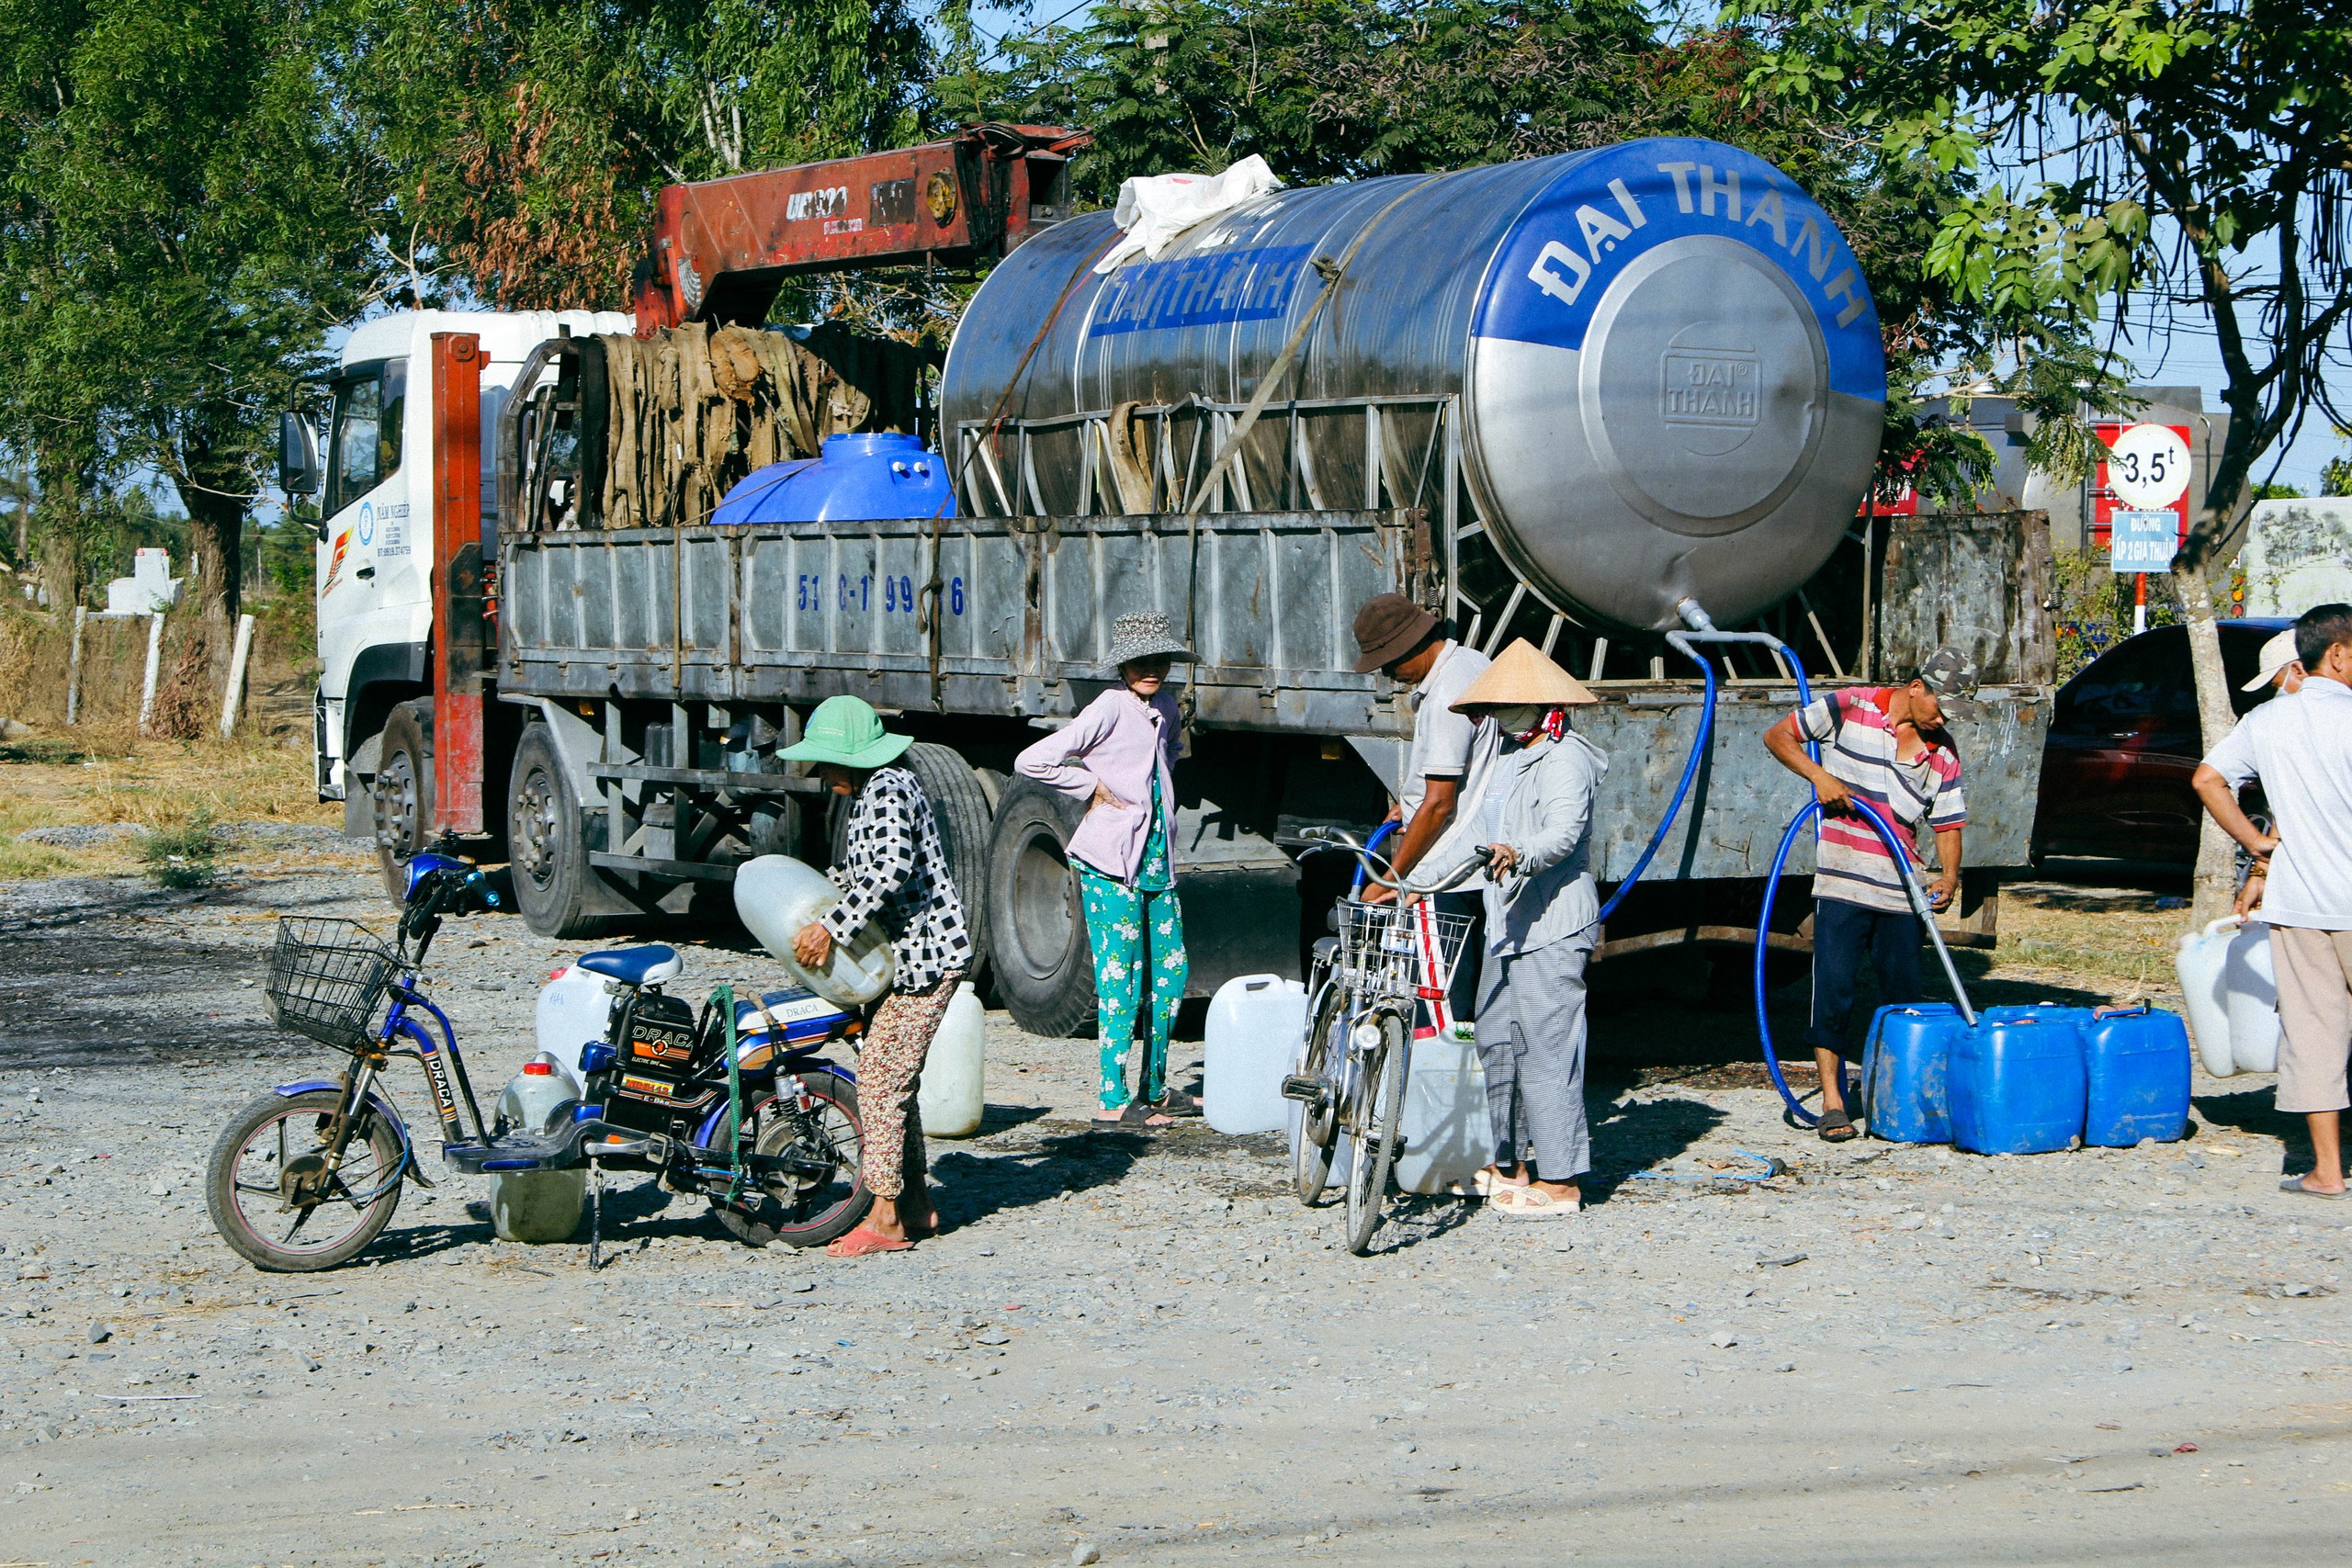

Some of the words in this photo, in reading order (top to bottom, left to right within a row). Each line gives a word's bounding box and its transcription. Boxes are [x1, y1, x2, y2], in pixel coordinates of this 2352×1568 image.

[1528, 177, 1647, 306] ĐẠI
[1657, 161, 1868, 330] THÀNH
[2127, 541, 2133, 561] 2
[786, 1004, 819, 1018] DRACA
[429, 1060, 454, 1108] DRACA
